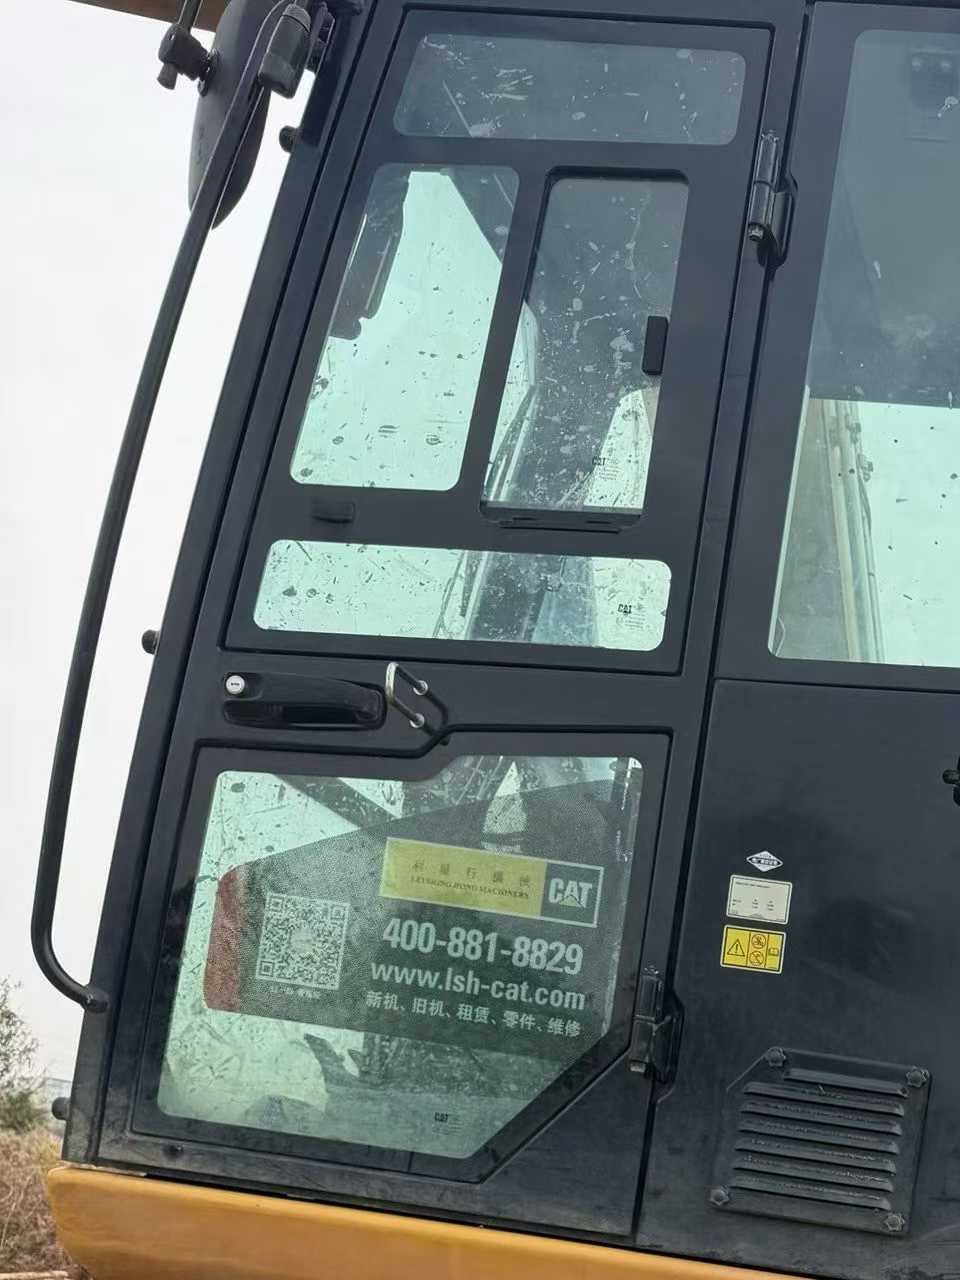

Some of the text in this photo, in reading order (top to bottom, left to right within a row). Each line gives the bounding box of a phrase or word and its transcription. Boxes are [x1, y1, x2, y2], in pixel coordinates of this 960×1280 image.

[549, 878, 593, 908] CAT
[382, 918, 584, 975] 400-881-8829
[370, 962, 586, 1010] www.lsh-cat.com
[366, 990, 581, 1038] 新机、旧机、租赁、零件、维修
